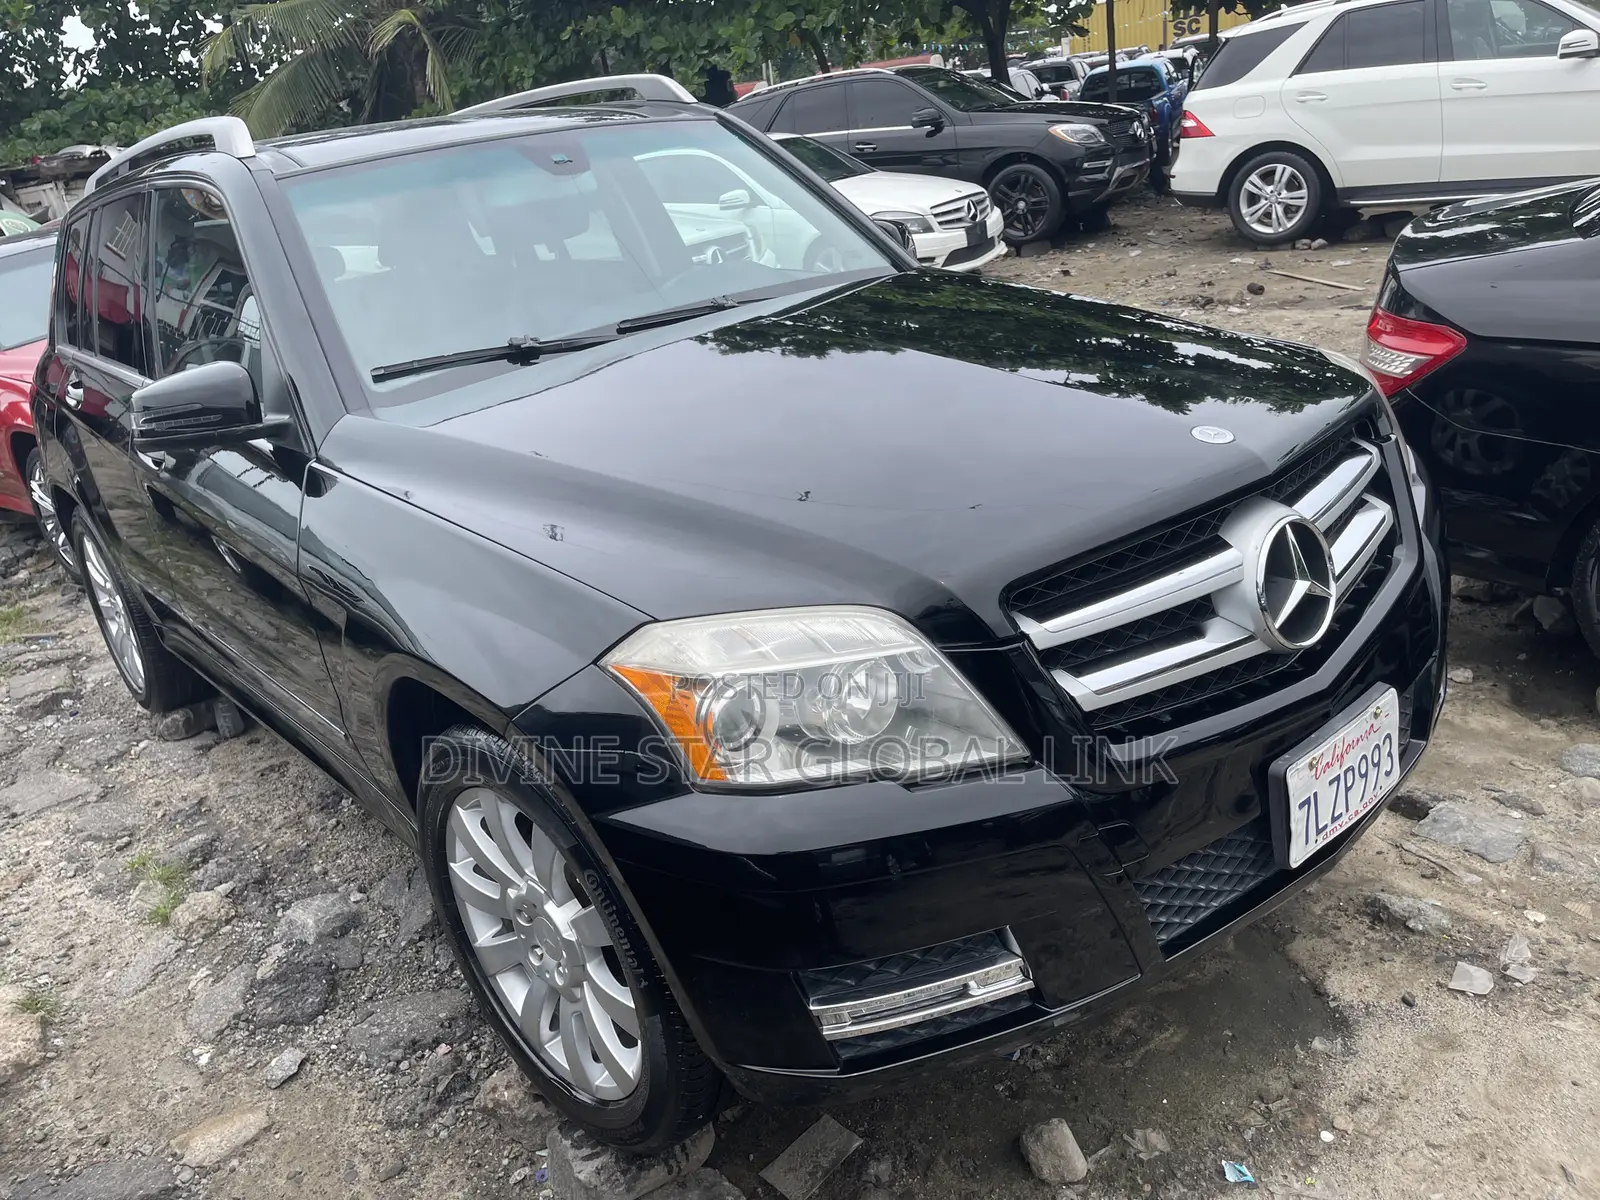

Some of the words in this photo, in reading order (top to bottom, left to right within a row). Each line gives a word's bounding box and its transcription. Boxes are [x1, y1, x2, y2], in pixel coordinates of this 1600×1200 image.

[1314, 723, 1381, 780] California
[1298, 732, 1394, 845] 7LZP993
[1322, 790, 1379, 841] dmv.ca.gov
